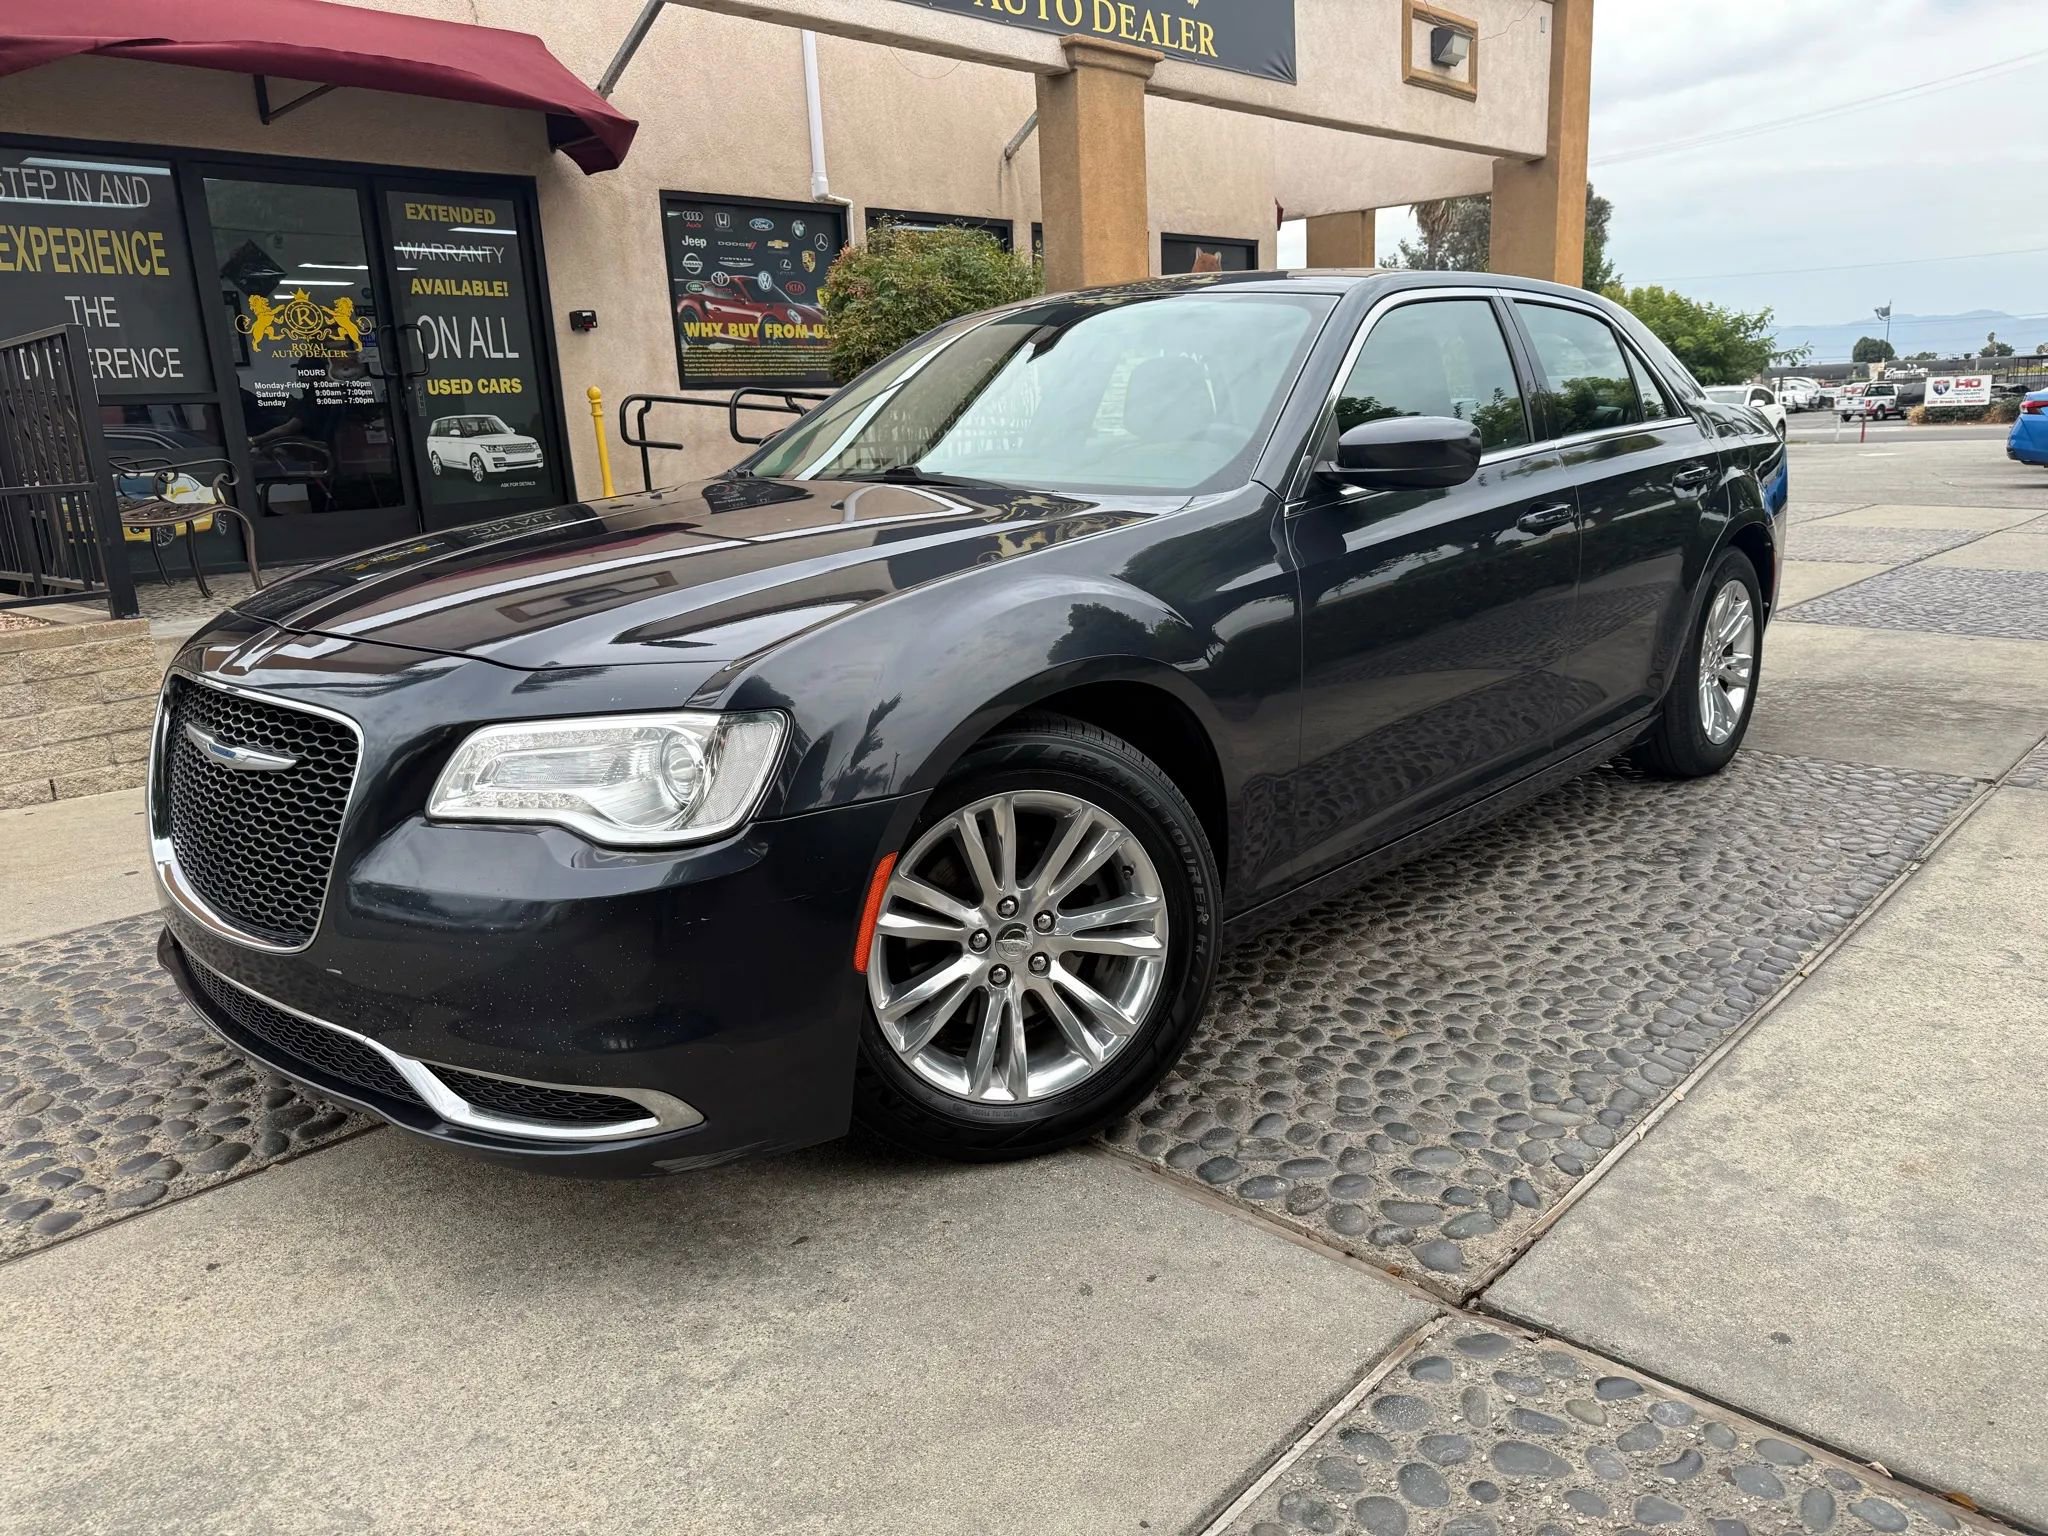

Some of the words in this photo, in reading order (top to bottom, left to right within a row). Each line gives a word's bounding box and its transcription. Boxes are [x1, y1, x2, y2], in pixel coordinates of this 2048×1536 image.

[974, 0, 1083, 27] TO
[1092, 0, 1218, 58] DEALER
[64, 171, 93, 204] IN
[99, 173, 151, 208] AND
[404, 202, 496, 225] EXTENDED
[0, 224, 170, 277] EXPERIENCE
[681, 235, 707, 249] Jeep
[400, 241, 505, 264] WARRANTY
[410, 278, 509, 297] AVAILABLE!
[64, 296, 120, 328] THE
[416, 315, 462, 360] ON
[469, 316, 520, 359] ALL
[684, 322, 723, 338] WHY
[728, 323, 760, 338] BUY
[765, 324, 809, 339] FROM
[271, 350, 303, 358] AUTO
[306, 350, 348, 358] DEALER
[291, 343, 327, 351] ROYAL
[18, 347, 184, 380] DIRENCE
[297, 369, 326, 377] HOURS
[254, 382, 310, 390] Monday-Friday
[256, 390, 290, 398] Saturday
[426, 379, 473, 395] USED
[477, 378, 523, 394] CARS
[257, 399, 286, 407] Sunday
[349, 397, 374, 405] 7:00pm
[1160, 810, 1211, 926] TOURER
